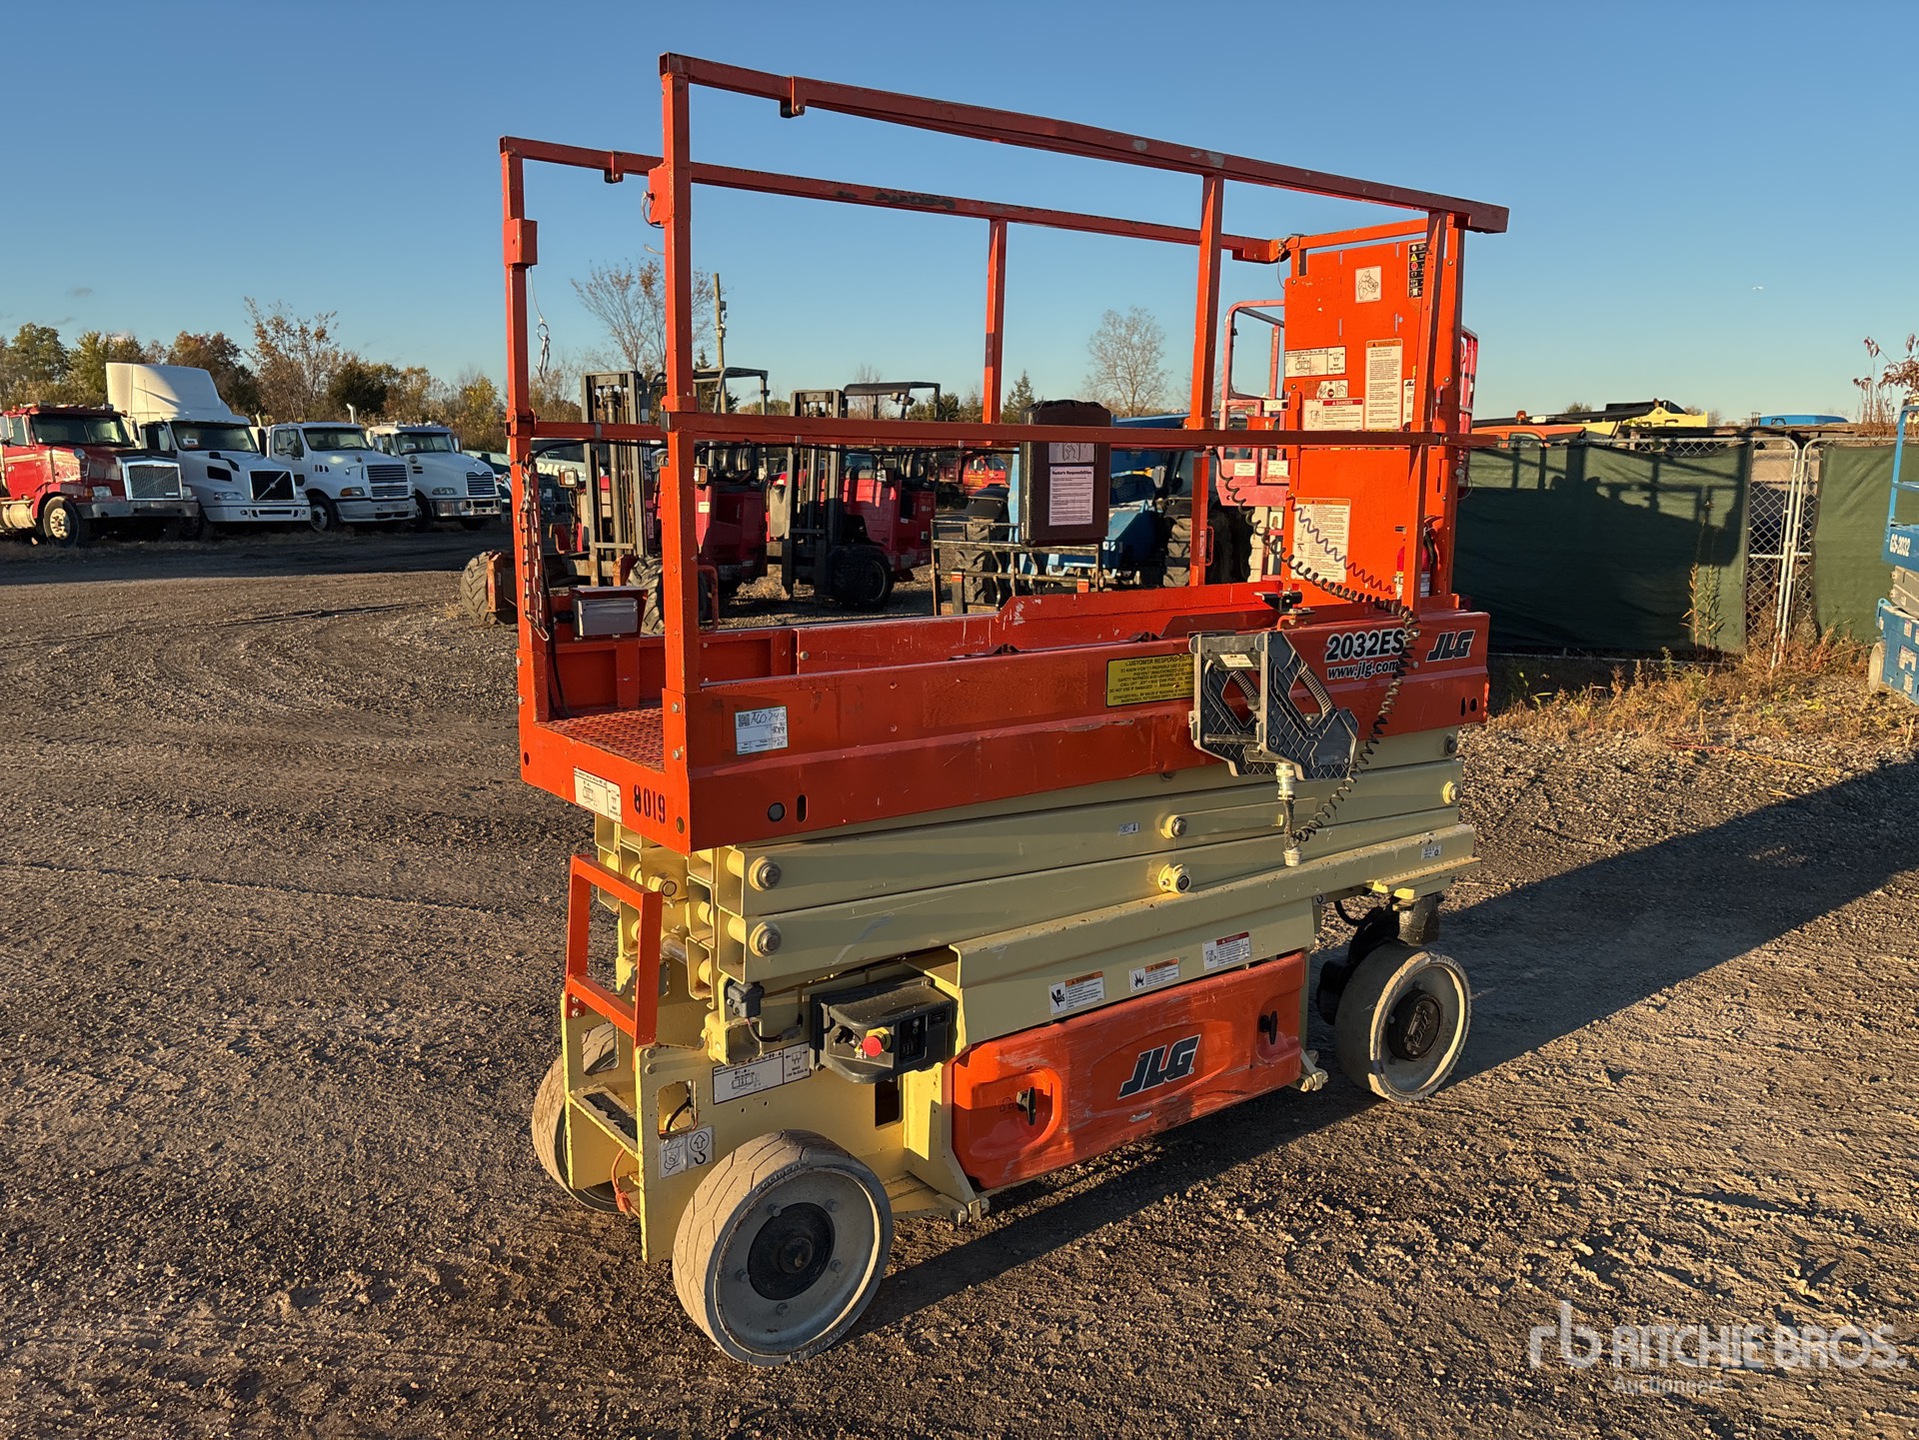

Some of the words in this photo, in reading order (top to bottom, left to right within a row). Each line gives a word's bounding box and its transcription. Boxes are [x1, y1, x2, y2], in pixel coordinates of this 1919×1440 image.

[1890, 533, 1911, 558] GS-2032
[1325, 628, 1406, 663] 2032ES
[1426, 629, 1475, 663] JLG
[1327, 659, 1400, 681] www.jlg.com
[634, 784, 665, 824] 8019
[1117, 1034, 1202, 1100] JLG
